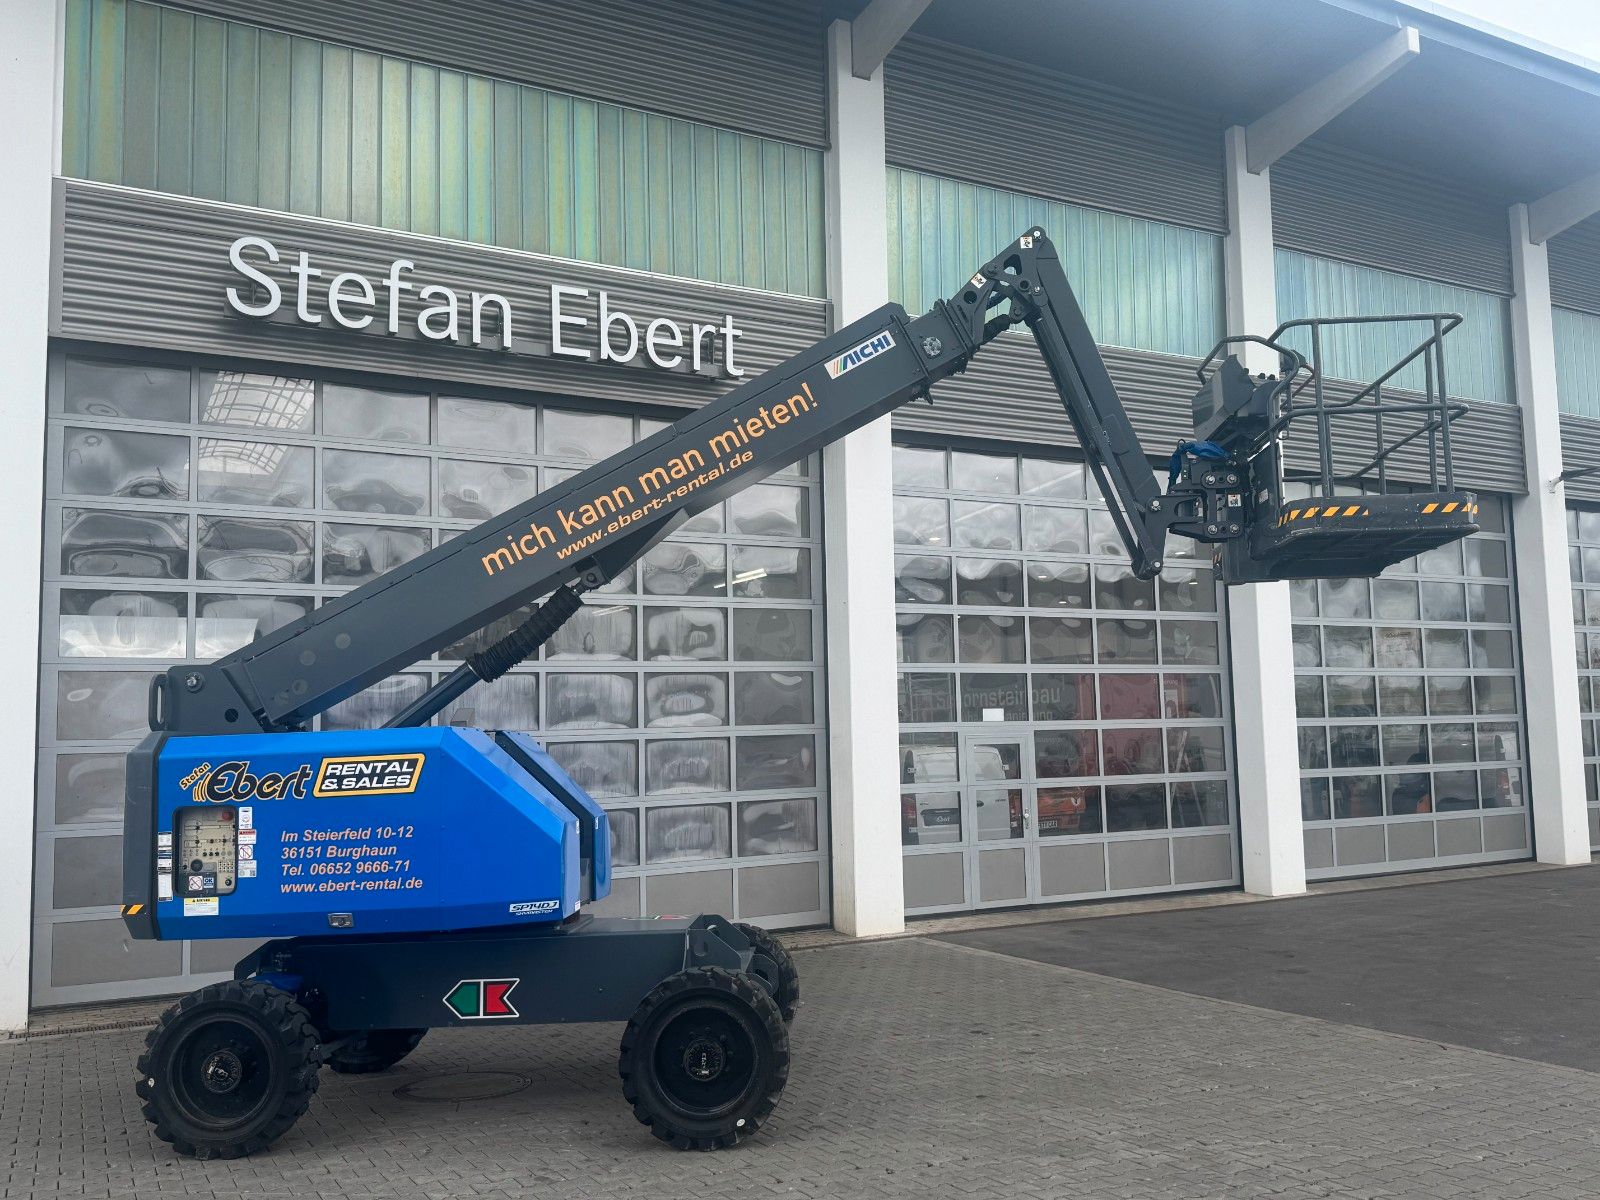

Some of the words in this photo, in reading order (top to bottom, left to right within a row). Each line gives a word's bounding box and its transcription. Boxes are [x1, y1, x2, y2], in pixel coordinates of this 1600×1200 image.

[226, 237, 512, 348] Stefan
[551, 284, 745, 377] Ebert
[833, 334, 892, 376] AICHI
[481, 523, 557, 575] mich
[557, 484, 634, 535] kann
[638, 447, 705, 496] man
[708, 382, 819, 457] mieten!
[556, 450, 754, 560] www.ebert-rental.de
[179, 762, 211, 790] Stefan
[325, 760, 414, 776] RENTAL
[206, 761, 313, 802] Ebert
[321, 780, 339, 790] &
[341, 775, 411, 788] SALES
[281, 830, 298, 842] Im
[303, 827, 371, 842] Steierfeld
[375, 825, 414, 839] 10-12
[281, 846, 322, 859] 36151
[326, 844, 398, 860] Burghaun
[281, 864, 305, 876] Tel.
[309, 862, 352, 876] 06652
[355, 860, 410, 874] 9666-71
[280, 877, 423, 893] www.ebert-rental.de
